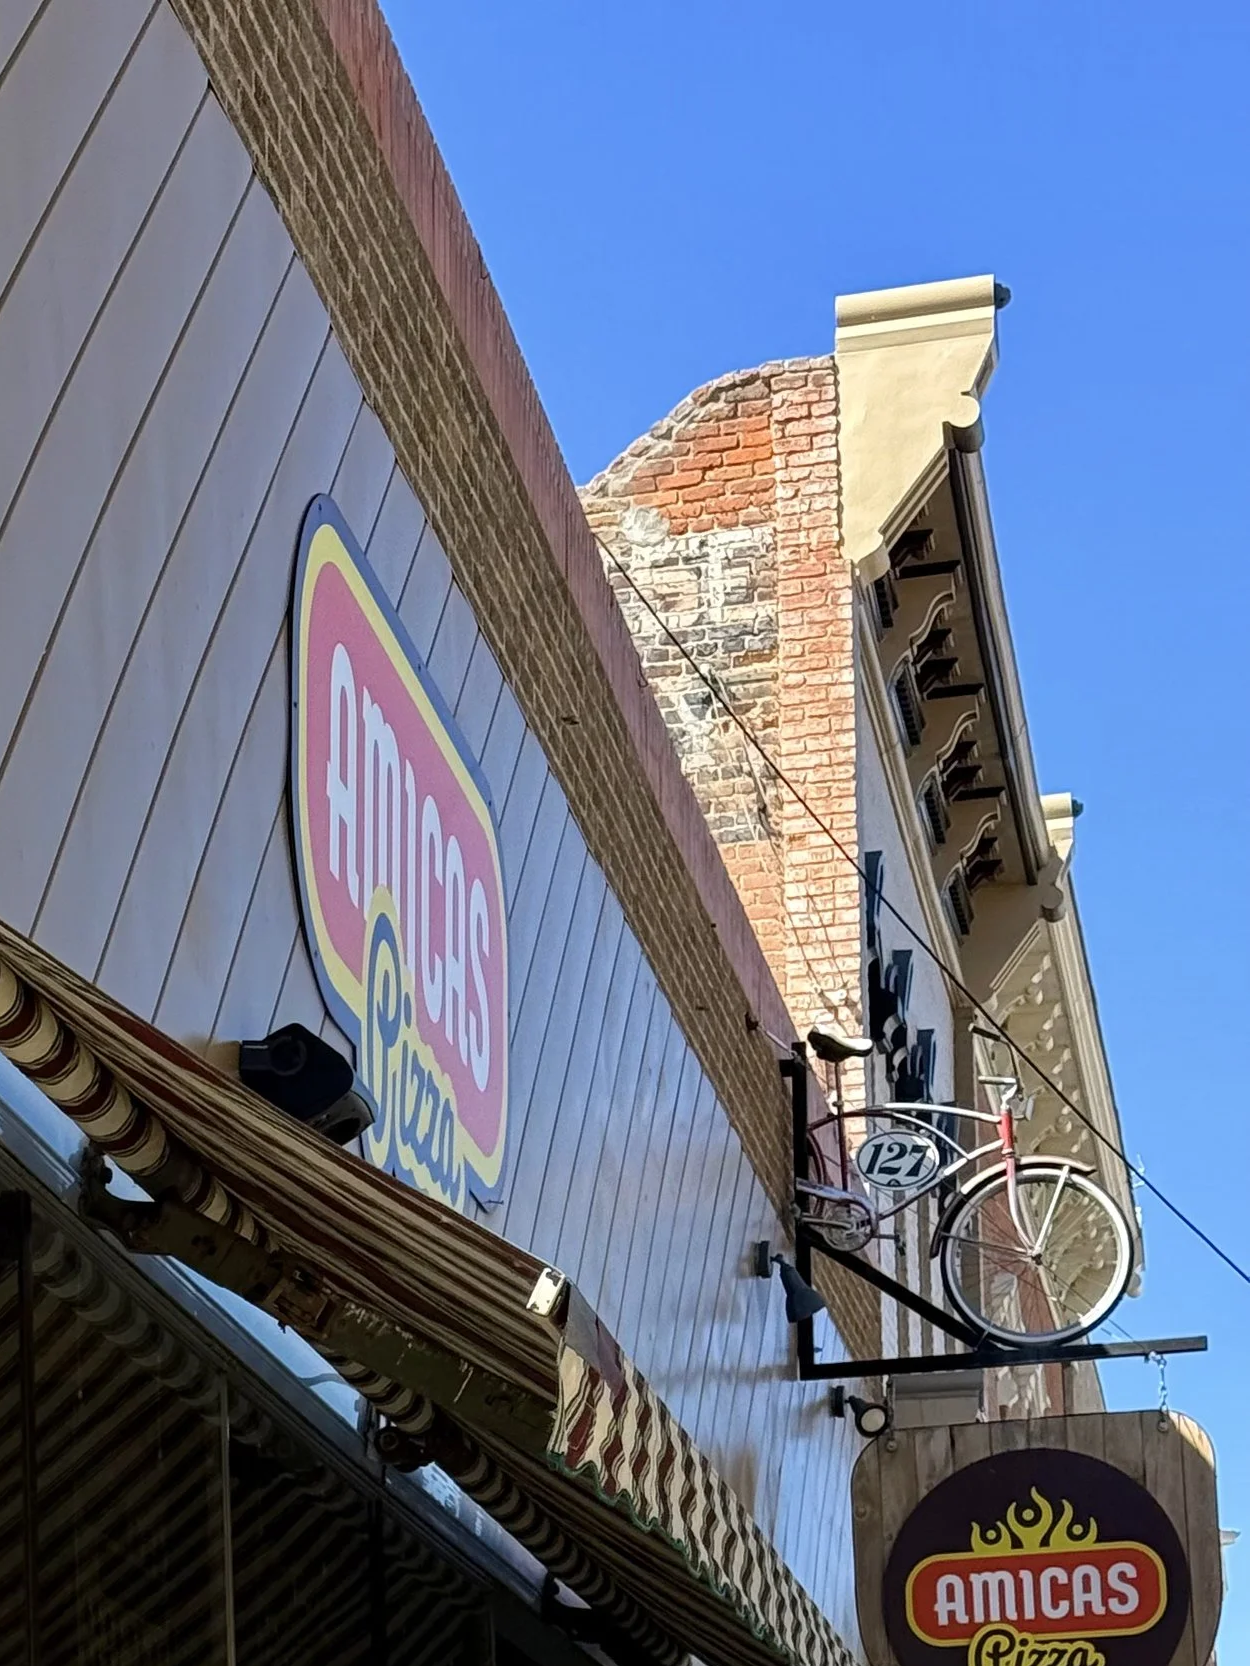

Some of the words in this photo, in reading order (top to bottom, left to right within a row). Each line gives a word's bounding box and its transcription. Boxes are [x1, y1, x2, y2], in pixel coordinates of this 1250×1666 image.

[327, 641, 490, 1092] AMICAS
[364, 912, 462, 1192] Pizza
[866, 1141, 930, 1178] 127
[933, 1562, 1140, 1627] AMICAS
